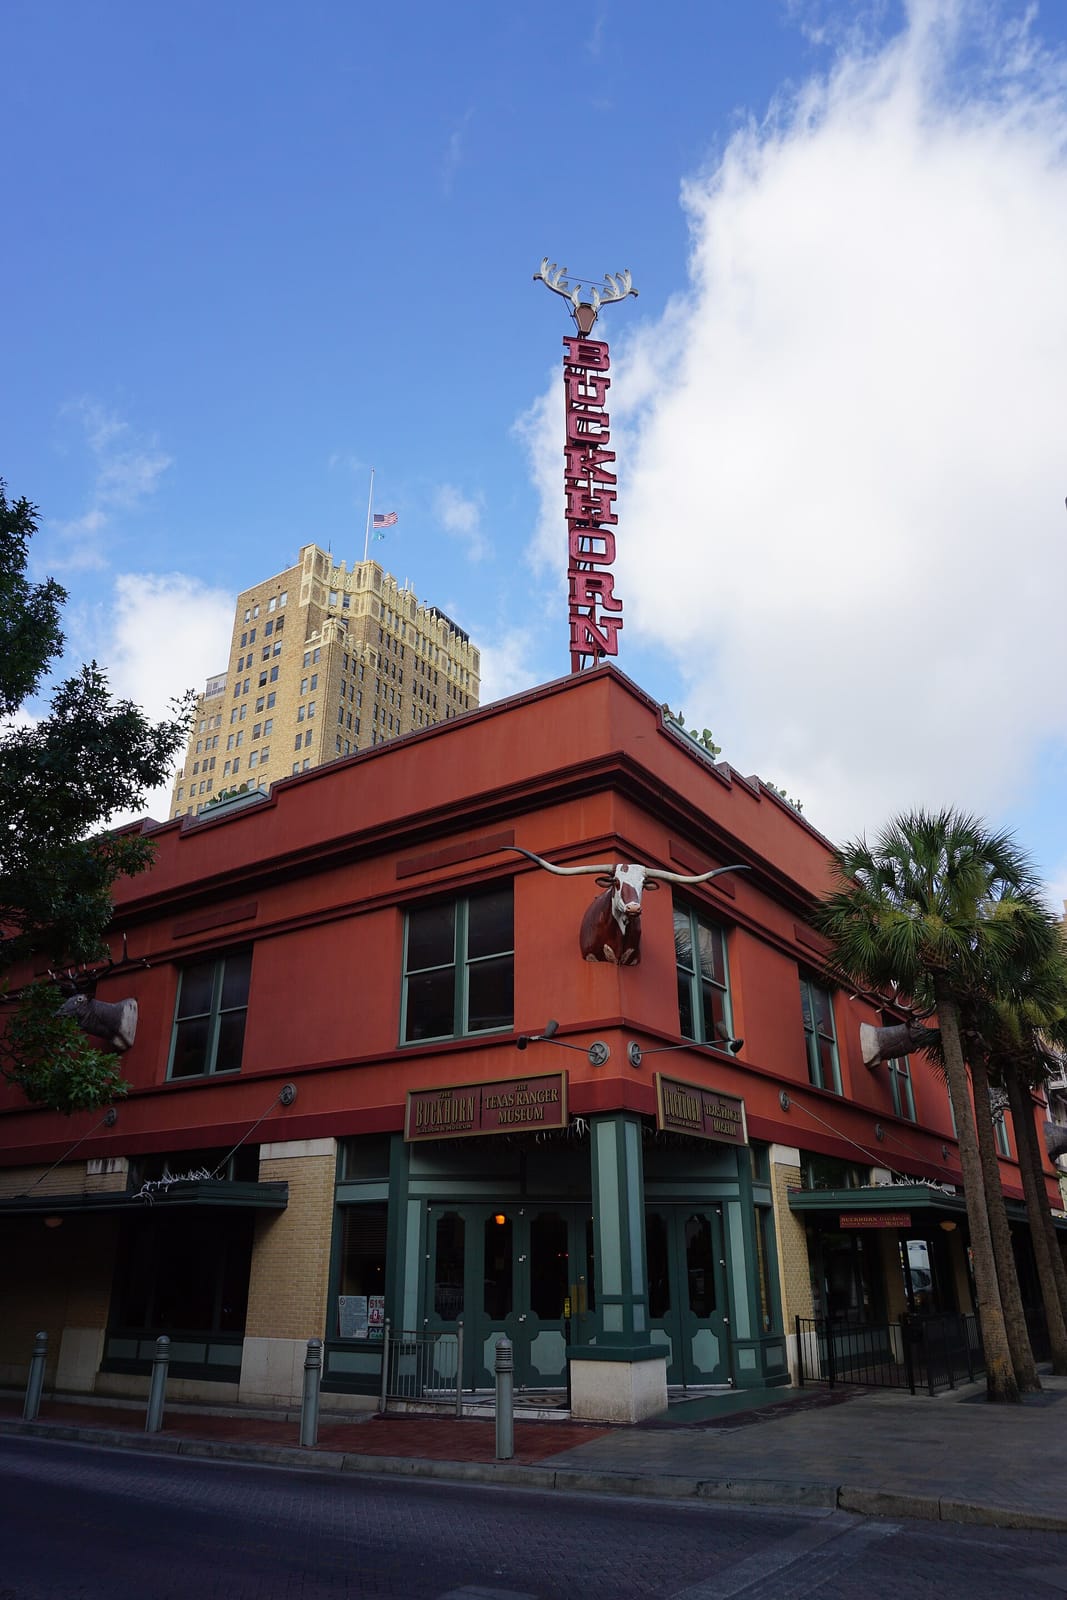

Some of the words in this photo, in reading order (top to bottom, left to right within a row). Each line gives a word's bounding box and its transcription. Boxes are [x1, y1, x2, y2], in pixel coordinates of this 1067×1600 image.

[563, 337, 623, 655] BUCKHORN
[416, 1097, 475, 1127] BUCKHORN
[486, 1094, 515, 1109] TEXAS
[515, 1088, 559, 1106] RANGER
[664, 1088, 700, 1122] BUCKHORN
[498, 1107, 544, 1123] MUSEUM
